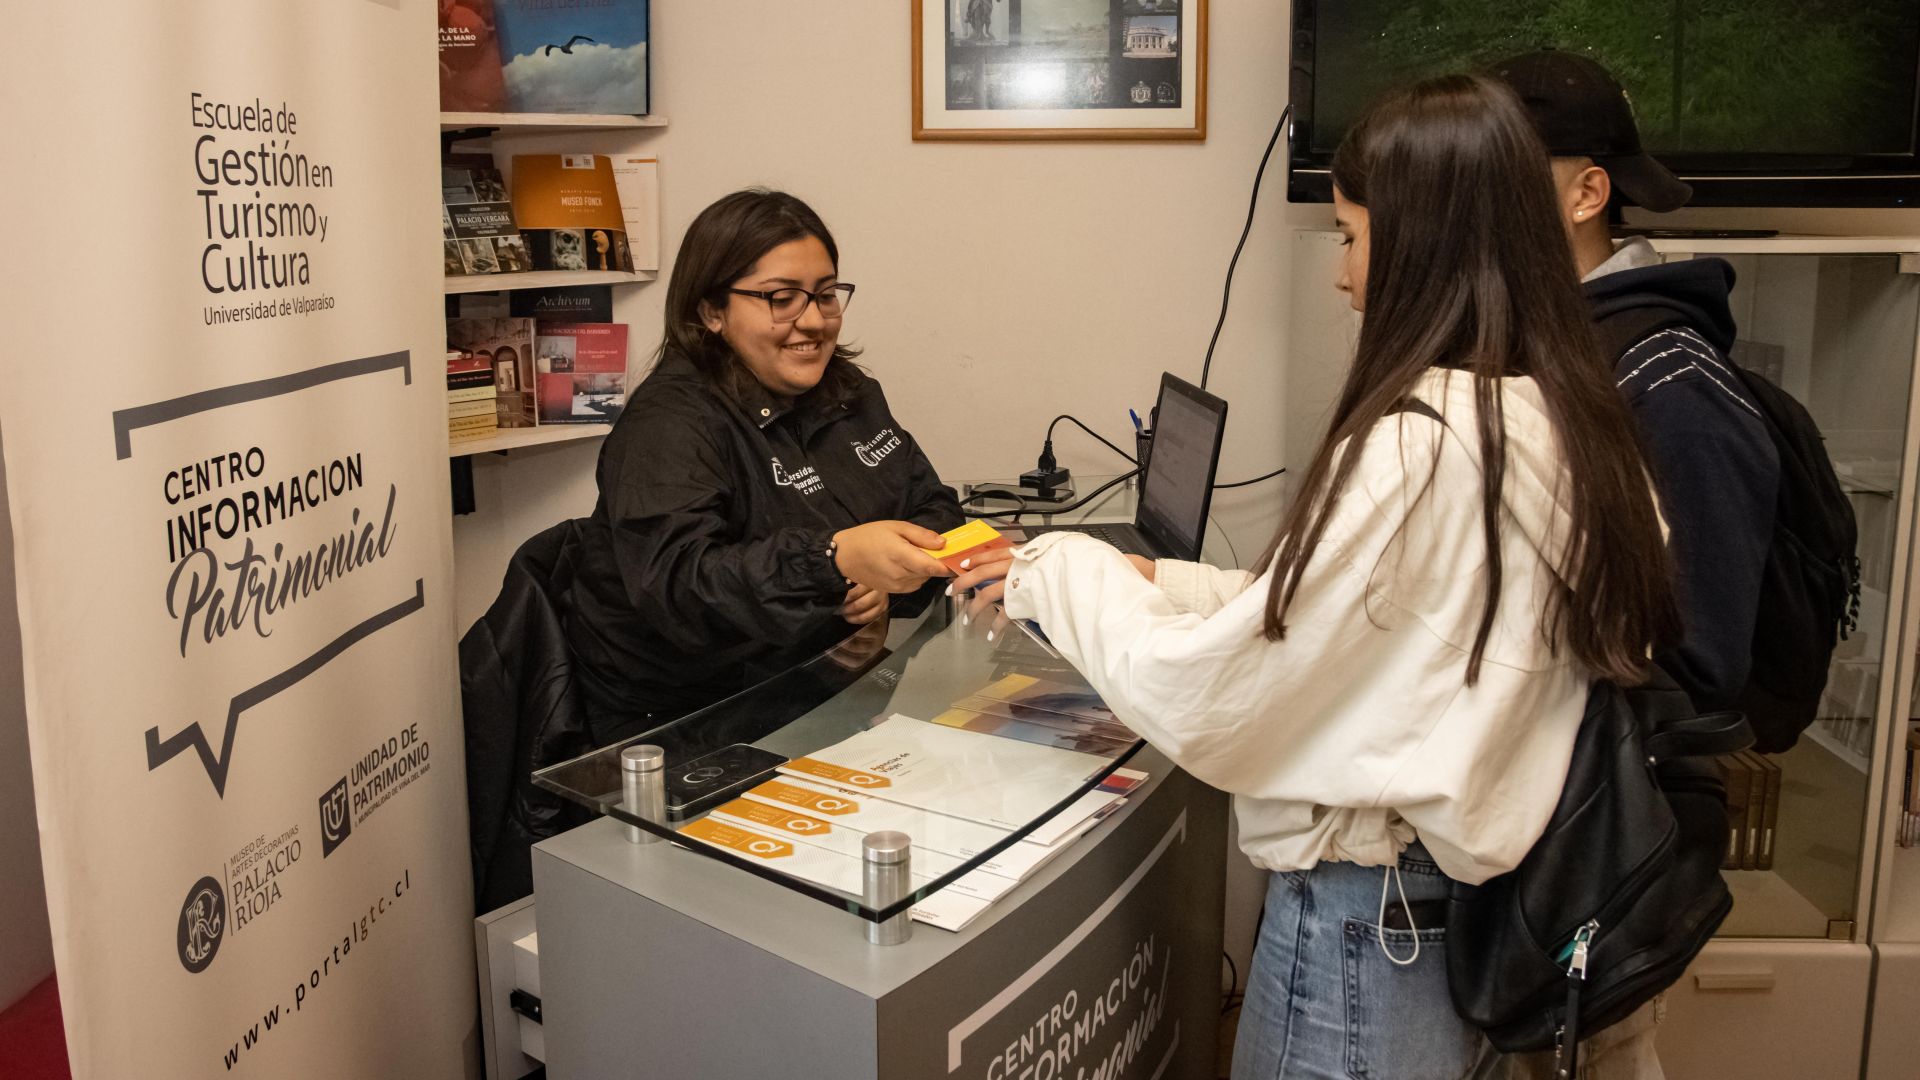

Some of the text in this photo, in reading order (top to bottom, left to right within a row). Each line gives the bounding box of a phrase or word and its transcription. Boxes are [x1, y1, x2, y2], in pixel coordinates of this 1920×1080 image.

[191, 92, 297, 135] Escuela de
[195, 134, 333, 188] Gestión en
[197, 190, 328, 243] Turismo y
[456, 216, 482, 225] PALACIO
[481, 214, 510, 223] VERGARA
[562, 196, 583, 207] MUSEO
[201, 240, 310, 294] Cultura
[204, 293, 335, 326] Universidad de Valparaíso
[536, 295, 591, 307] Archivum
[164, 446, 265, 505] CENTRO
[803, 482, 825, 496] CHIL
[167, 453, 363, 563] INFORMACION
[166, 483, 397, 659] Patrimonial
[351, 722, 419, 787] UNIDAD DE
[353, 741, 430, 815] PATRIMONIO
[358, 791, 392, 825] MUNICIPALIDAD
[391, 785, 399, 797] DE
[411, 771, 420, 782] DEL
[420, 762, 431, 776] MAR
[230, 834, 266, 866] MUSEO DE
[231, 824, 299, 880] ARTES DECORATIVAS
[232, 839, 301, 906] PALACIO
[235, 880, 282, 931] RIOJA
[223, 869, 411, 1072] www.portalgtc.cl
[1019, 933, 1154, 1080] ORMACIÓN
[987, 989, 1078, 1080] CENTRO
